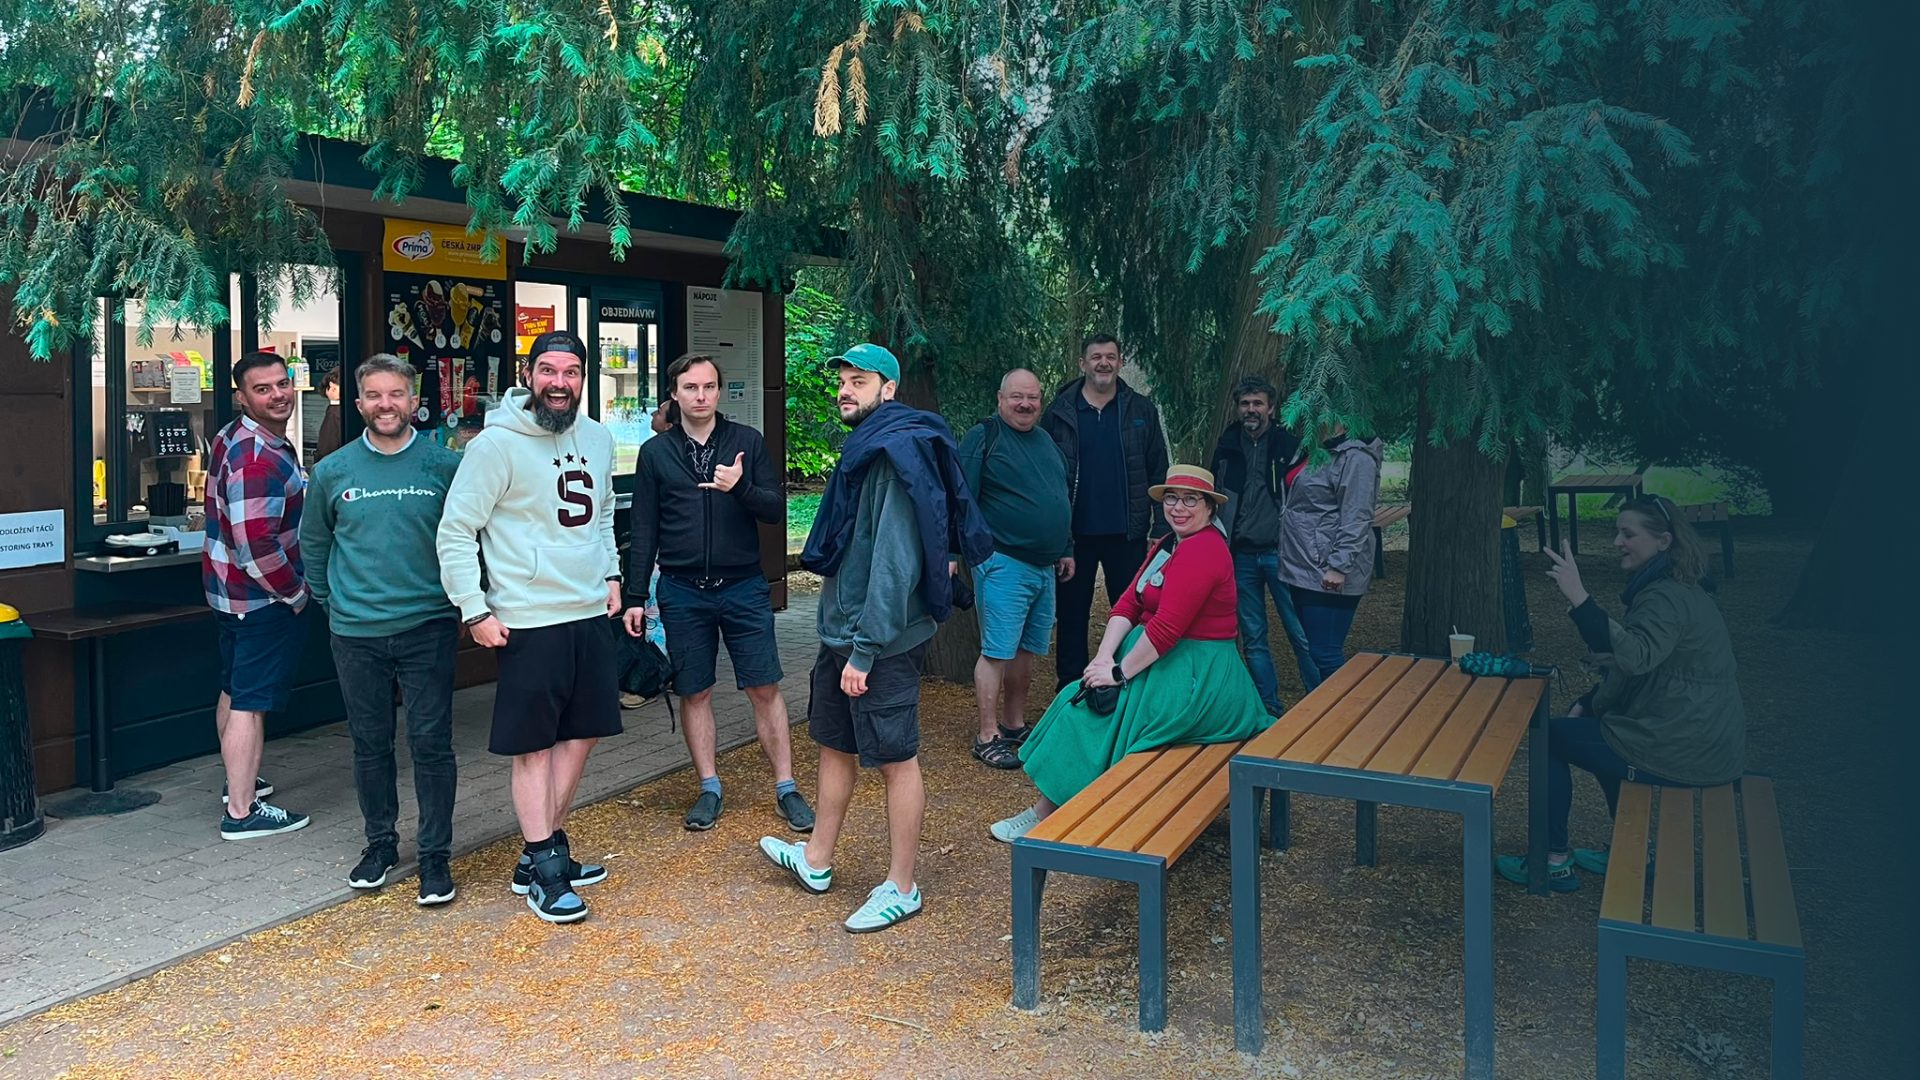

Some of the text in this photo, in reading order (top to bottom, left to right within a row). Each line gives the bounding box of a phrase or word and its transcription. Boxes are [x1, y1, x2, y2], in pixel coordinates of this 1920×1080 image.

[402, 241, 428, 253] Prima
[441, 238, 465, 250] ČESKÁ
[601, 306, 656, 319] OBJEDNÁVKY
[341, 485, 436, 501] Champion
[557, 470, 594, 527] S
[36, 523, 54, 532] TÁCŮ
[0, 541, 54, 552] STORING TRAYS
